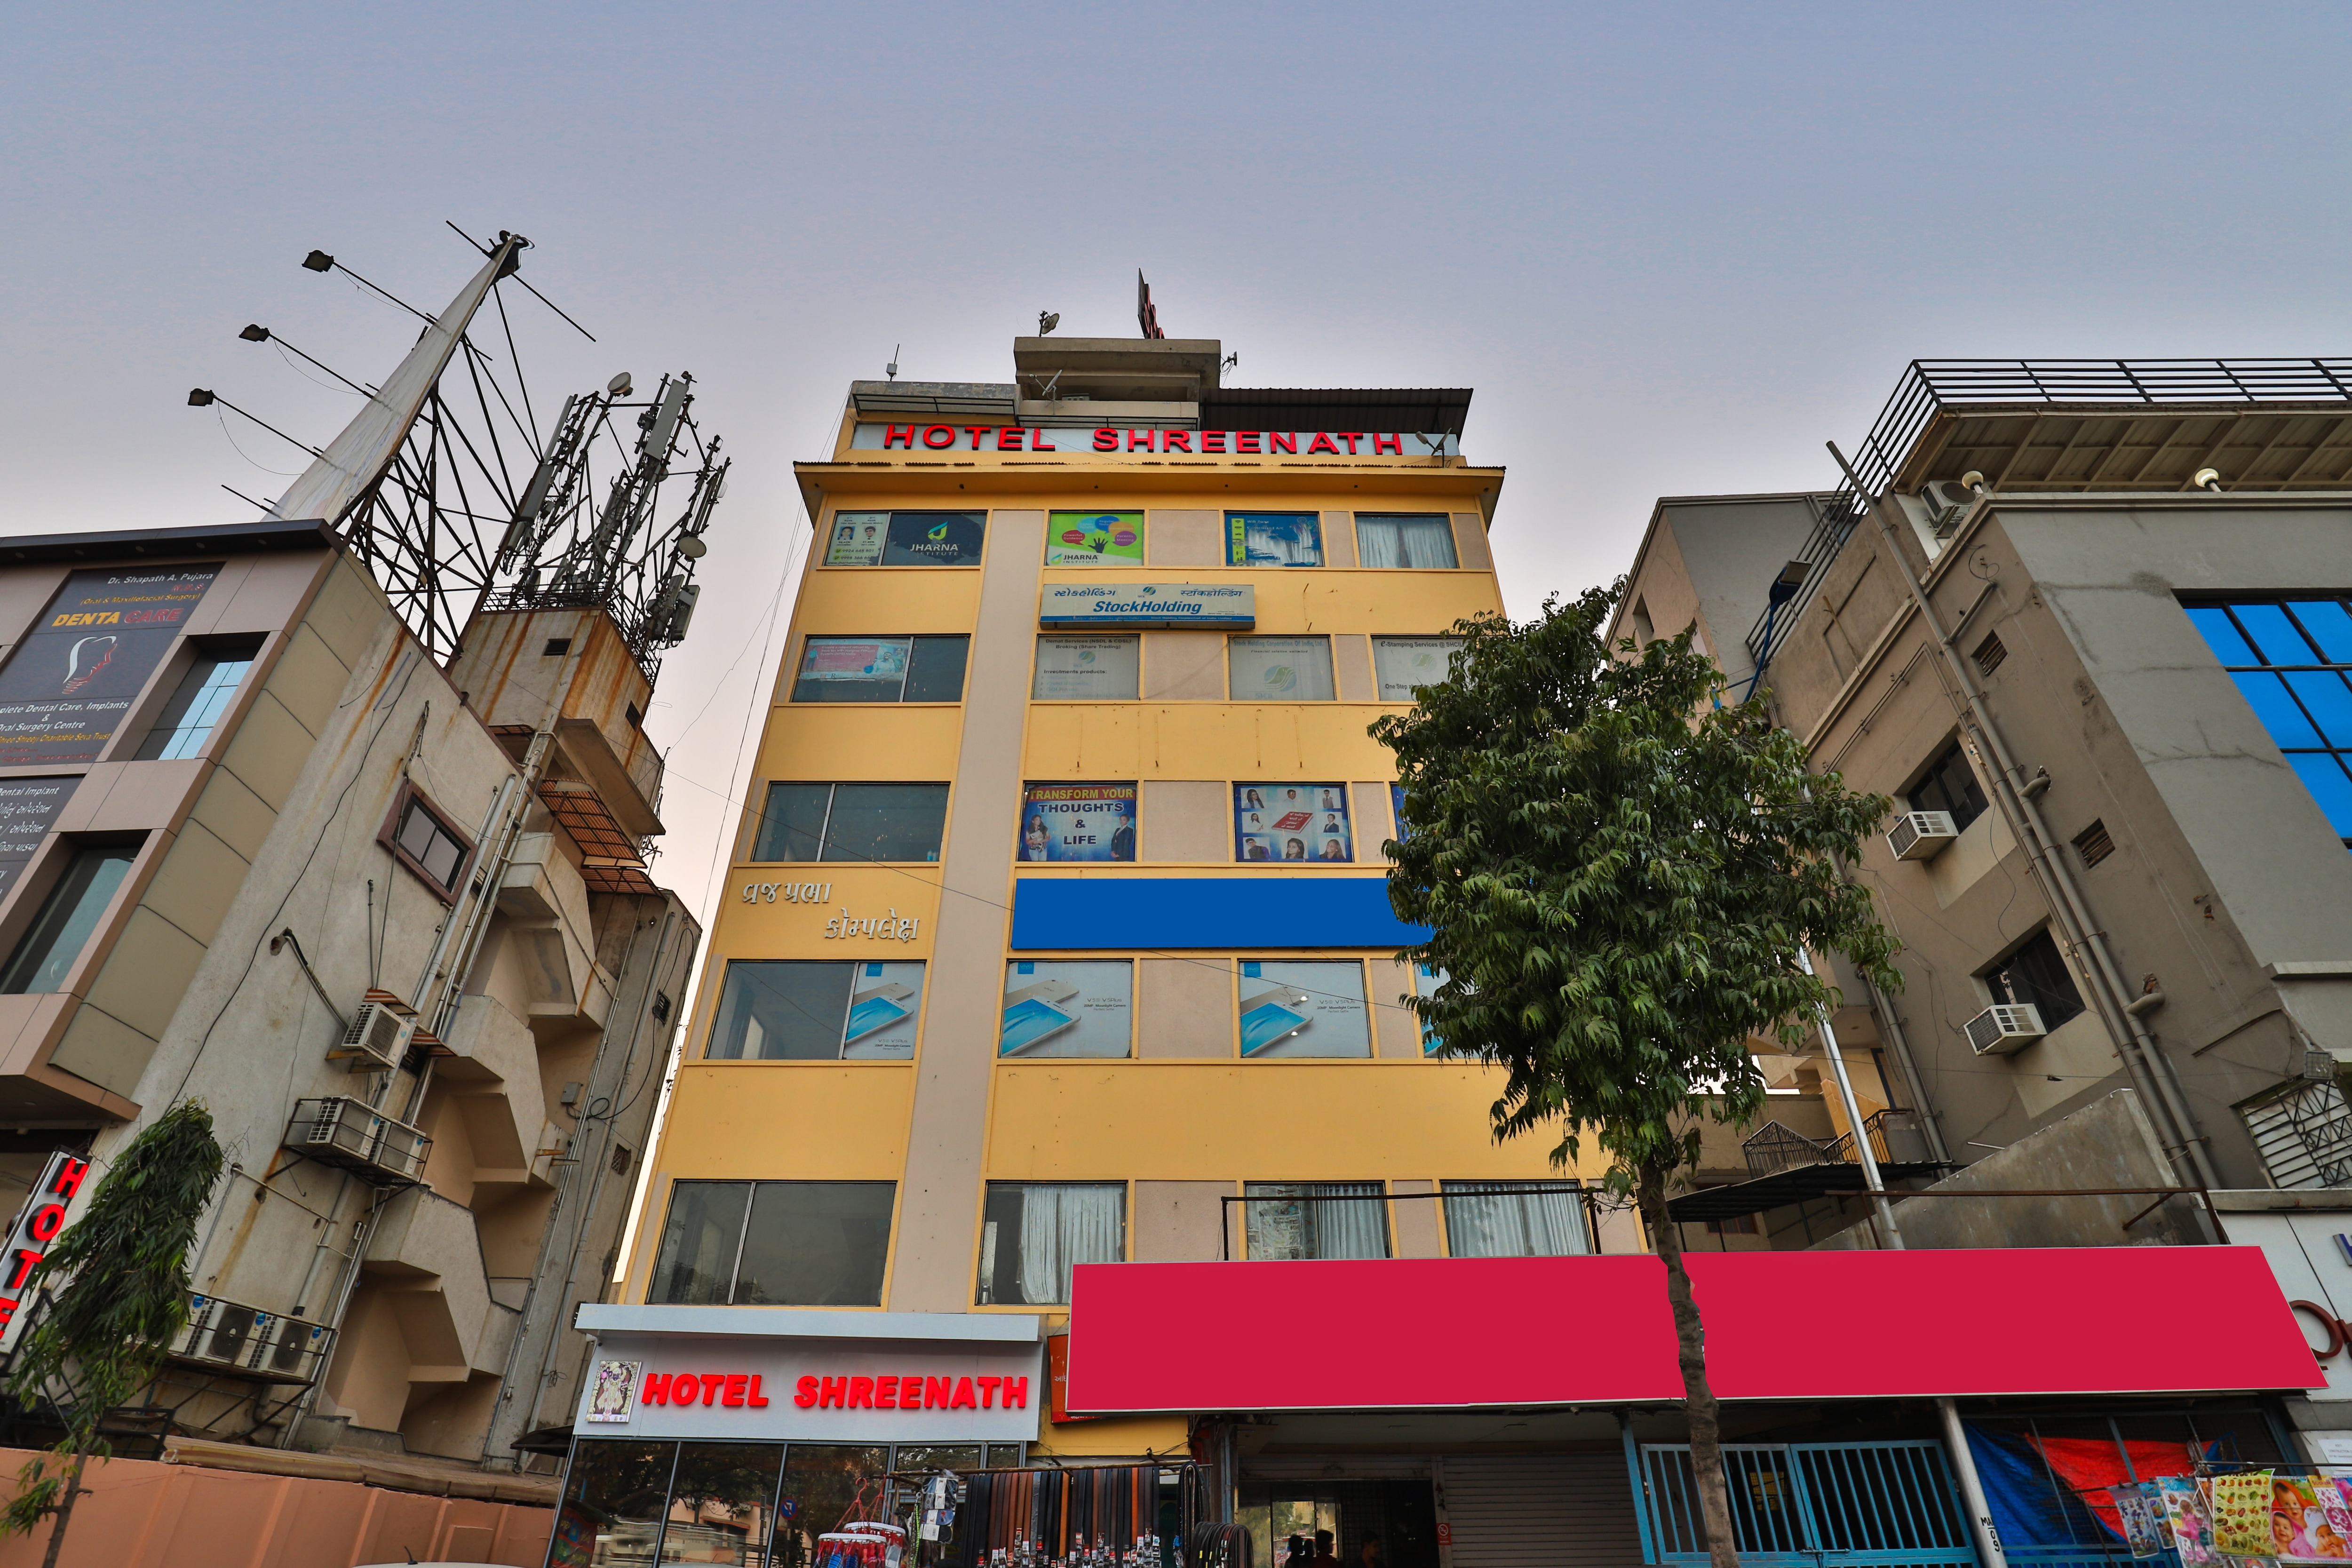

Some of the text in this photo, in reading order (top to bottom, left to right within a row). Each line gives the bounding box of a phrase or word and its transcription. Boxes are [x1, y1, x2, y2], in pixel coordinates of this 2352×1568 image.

[884, 424, 1402, 455] HOTEL SHREENATH
[124, 575, 165, 584] Shapath
[180, 573, 214, 581] Pujara
[1093, 601, 1202, 614] StockHolding
[51, 608, 184, 627] DENTA CARE
[25, 704, 59, 713] Dental
[59, 703, 84, 712] Care,
[86, 701, 129, 711] Implants
[16, 723, 53, 732] Surgery
[40, 733, 74, 742] Charitable
[75, 732, 91, 740] Seva
[24, 786, 60, 796] Implant
[1030, 789, 1133, 799] TRANSFORM YOUR
[16, 801, 52, 814] ઓપરેશન
[1038, 803, 1124, 813] THOUGHTS
[9, 820, 46, 834] ઓપરેશન
[1075, 819, 1086, 828] &
[1064, 836, 1097, 845] LIFE
[16, 843, 38, 852] પાડવા
[641, 1373, 1028, 1408] HOTEL SHREENATH
